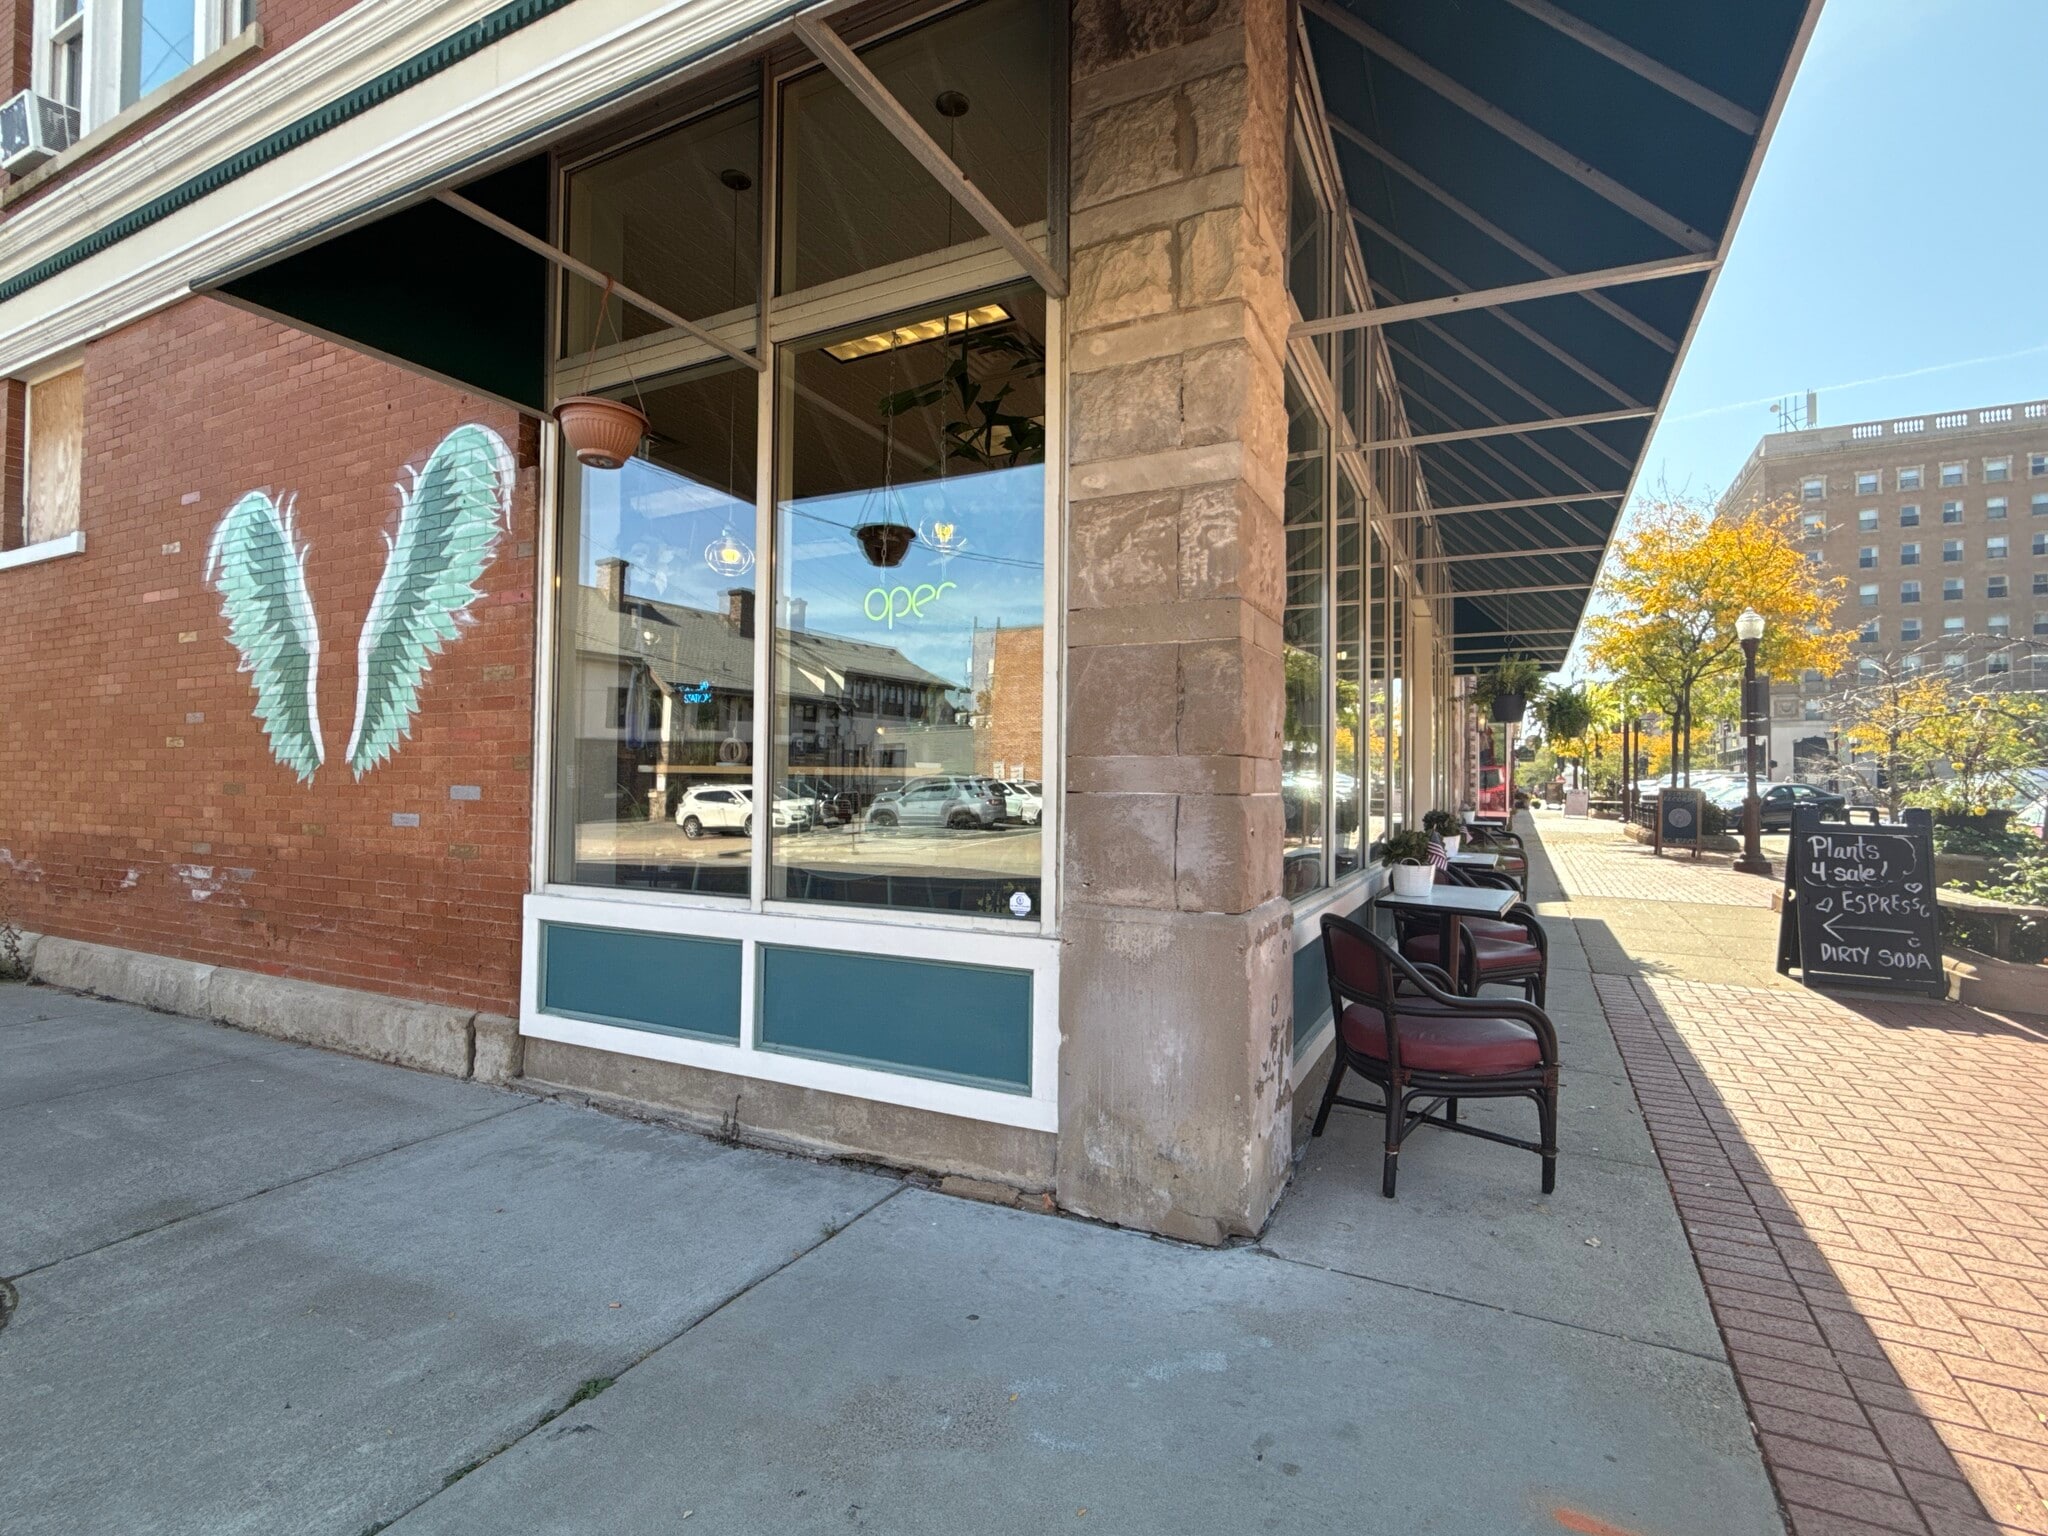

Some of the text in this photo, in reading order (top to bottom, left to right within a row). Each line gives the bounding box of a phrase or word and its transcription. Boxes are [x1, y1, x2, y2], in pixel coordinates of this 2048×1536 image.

[1807, 835, 1880, 862] Plants
[1811, 861, 1888, 882] 4 sale!
[1820, 943, 1933, 970] DIRTY SODA
